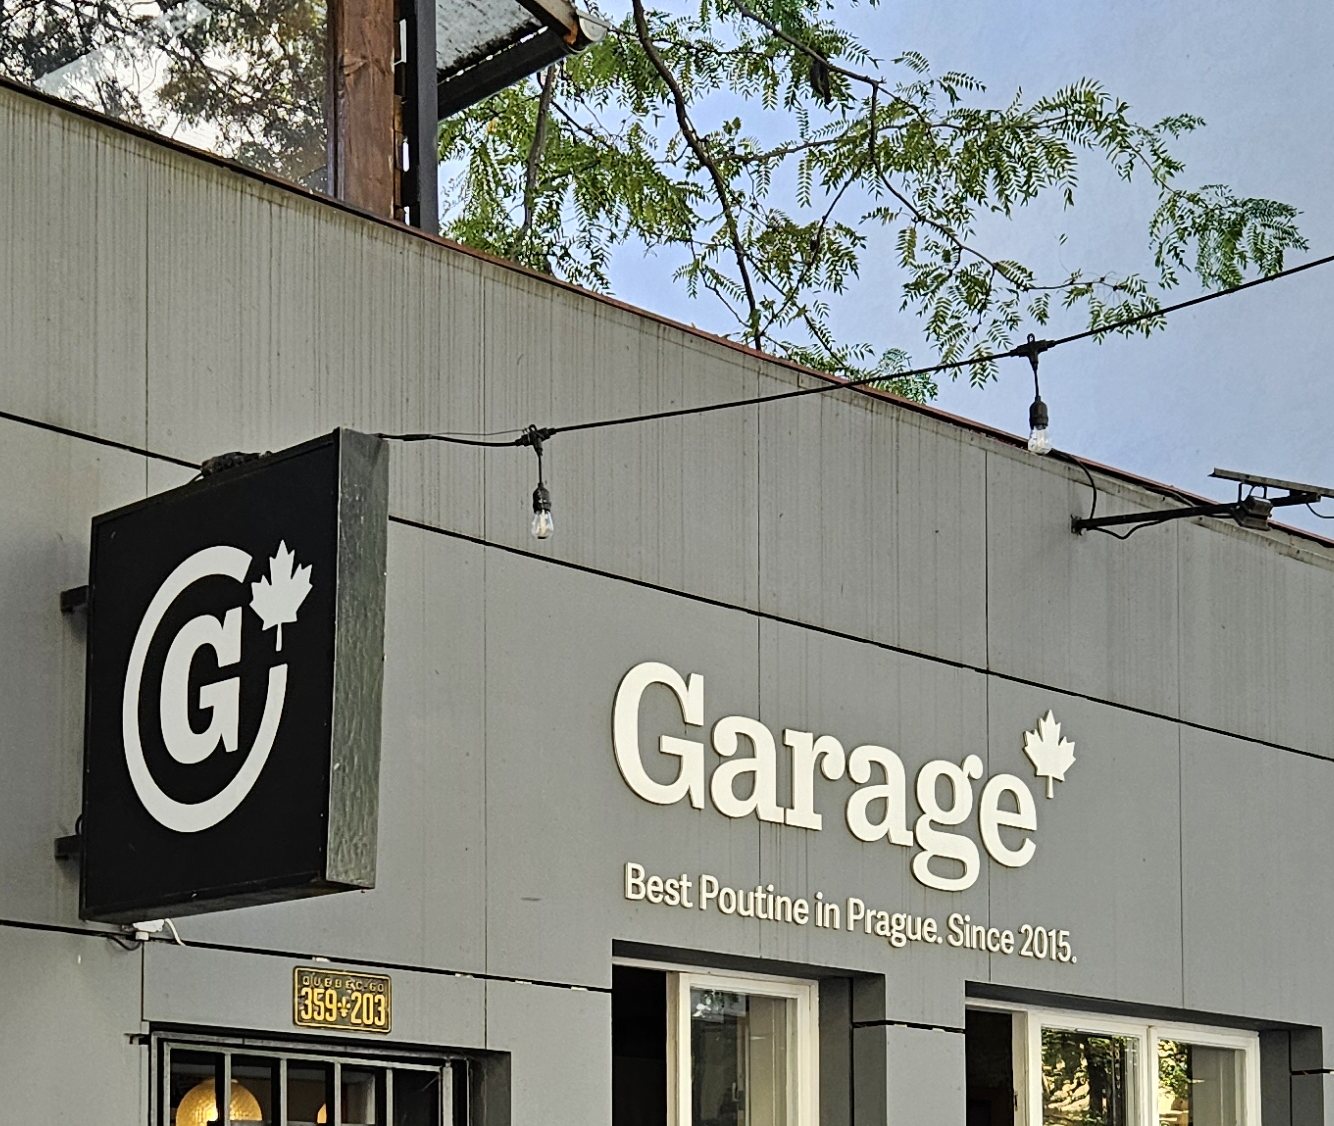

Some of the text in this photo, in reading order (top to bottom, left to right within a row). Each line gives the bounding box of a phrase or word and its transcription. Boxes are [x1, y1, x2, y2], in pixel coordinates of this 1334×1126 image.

[612, 661, 1038, 892] Garage
[624, 862, 1078, 964] Best Poutine in Prague. Since 2015.
[300, 987, 386, 1026] 359 203
